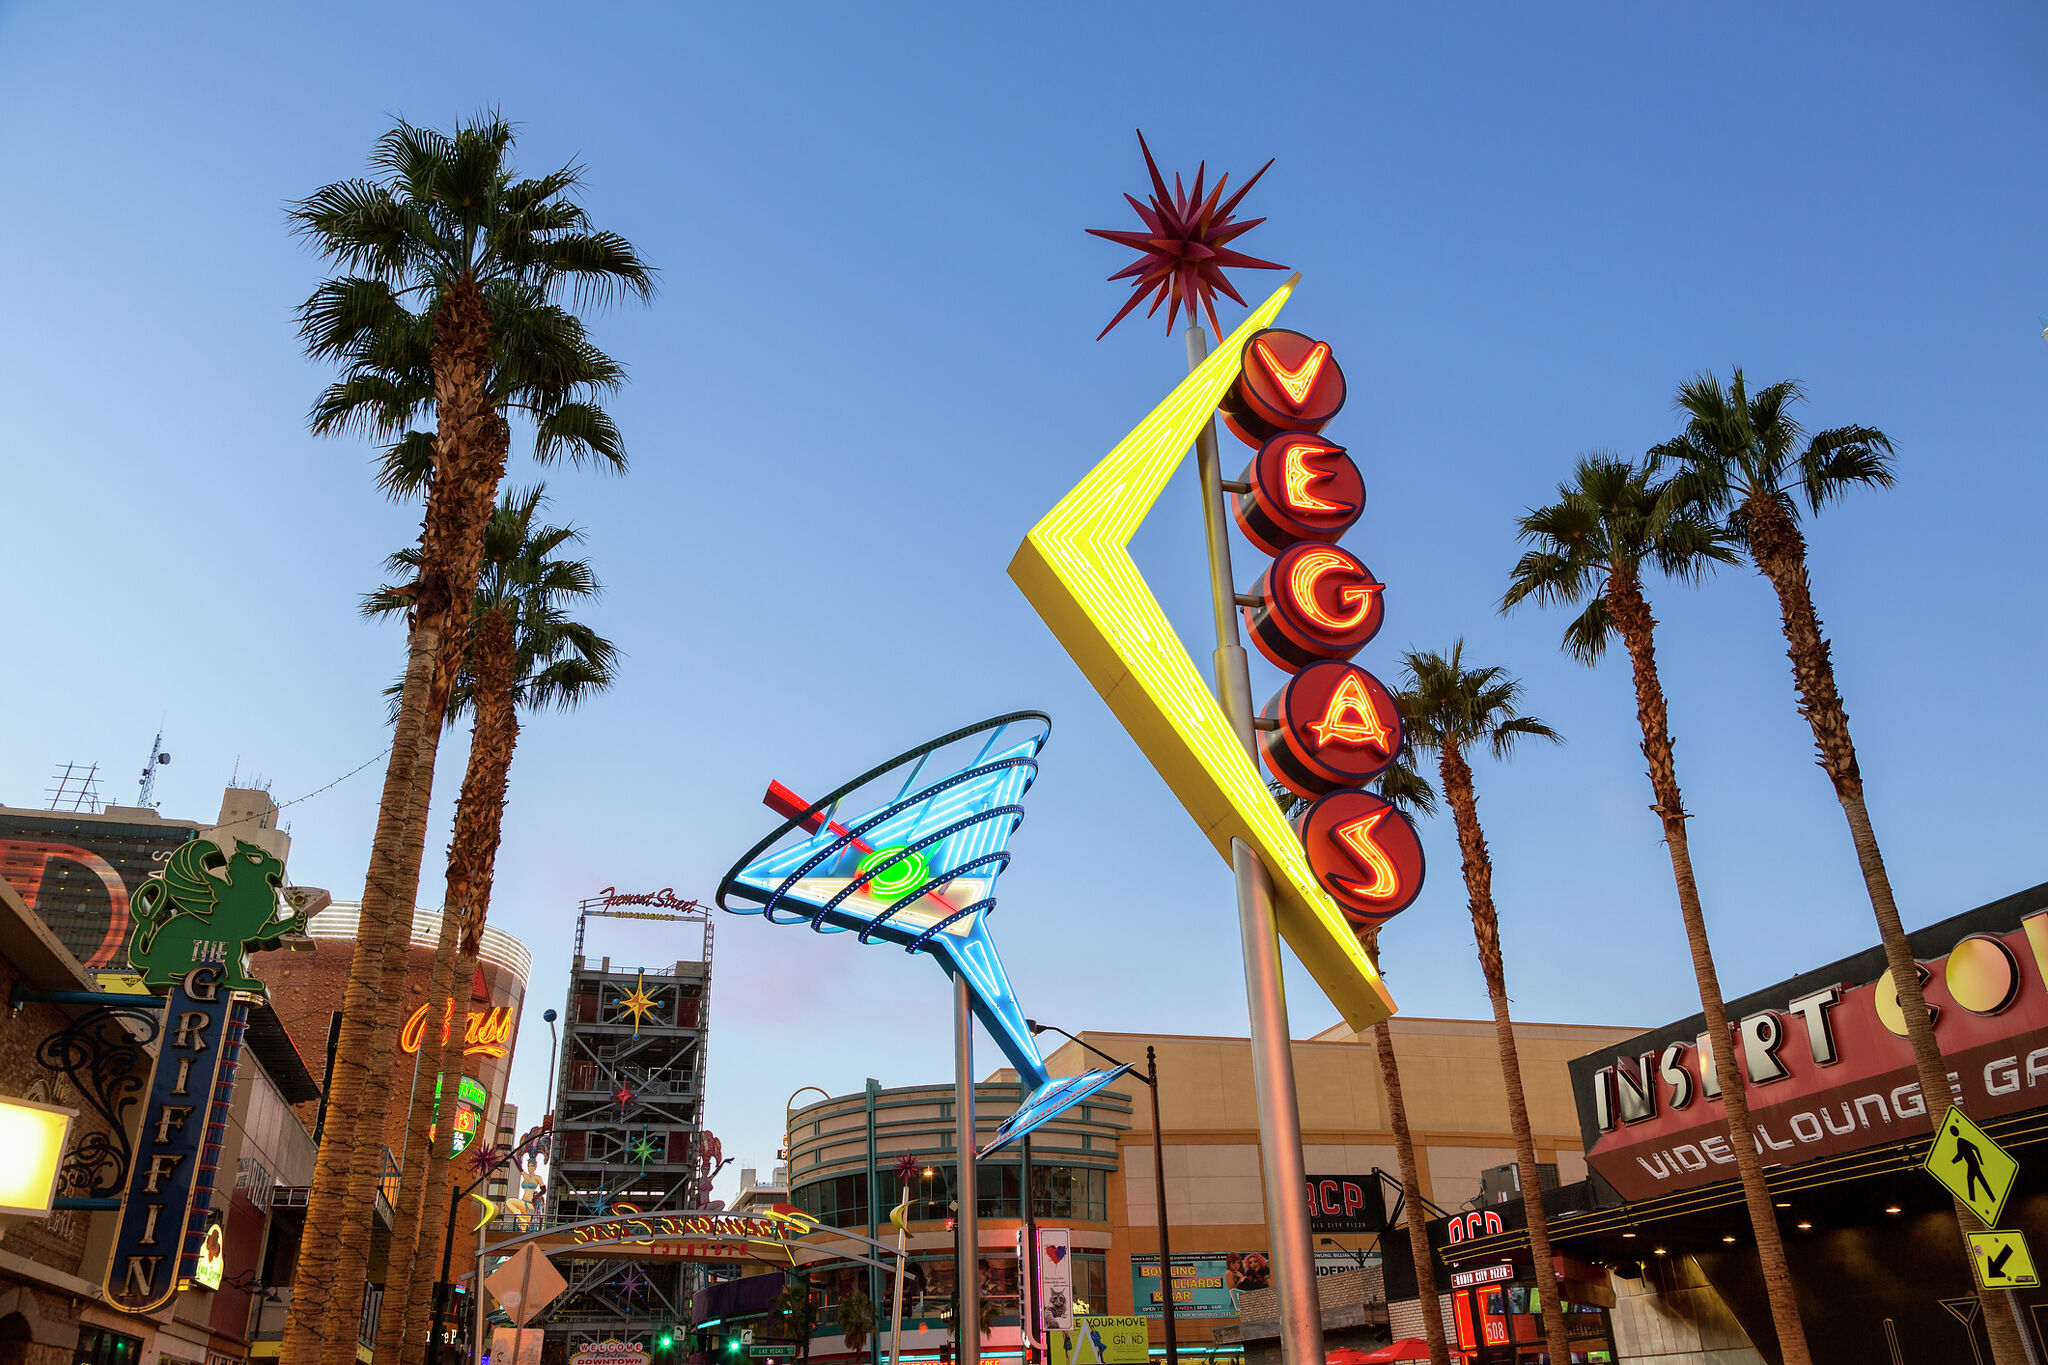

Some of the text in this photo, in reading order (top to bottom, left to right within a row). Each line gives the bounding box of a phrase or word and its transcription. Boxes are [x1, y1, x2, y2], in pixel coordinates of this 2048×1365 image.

[1252, 338, 1401, 901] VEGAS
[600, 886, 698, 914] Fremont Street
[615, 911, 675, 921] EXPERIENCE
[191, 939, 228, 963] THE
[1594, 982, 1841, 1134] INSERT
[117, 965, 222, 1299] GRIFFIN
[1171, 1278, 1222, 1290] ILLIARDS
[1456, 1266, 1508, 1286] RADIO CITY PIZZA
[1087, 1317, 1114, 1327] YOUR
[1116, 1317, 1146, 1327] MOVE
[1486, 1321, 1505, 1340] 508
[580, 1344, 643, 1353] WELCOME
[1112, 1335, 1144, 1345] GRAND
